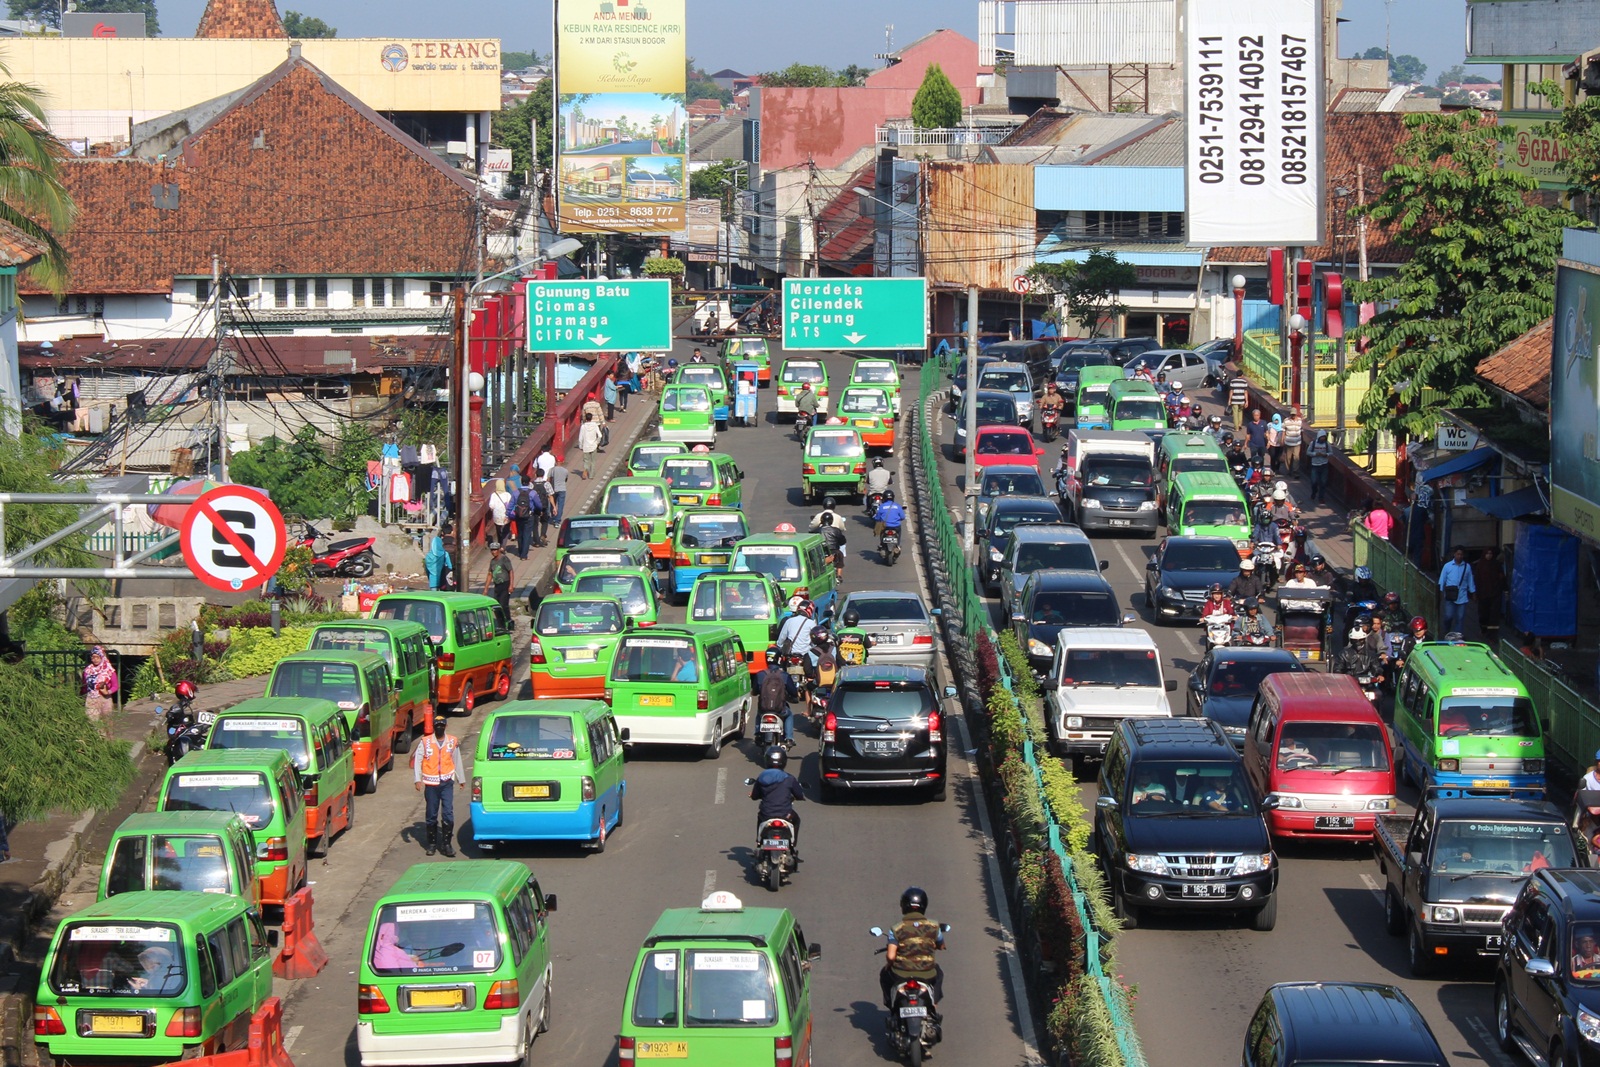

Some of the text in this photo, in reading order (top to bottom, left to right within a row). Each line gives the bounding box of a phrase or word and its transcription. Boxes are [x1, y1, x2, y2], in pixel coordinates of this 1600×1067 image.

[593, 12, 652, 21] ANDA MENUJU
[563, 24, 681, 36] KEBUN RAYA RESIDENCE (KRR)
[411, 42, 498, 59] TERANG
[597, 74, 651, 86] Kebun Raya
[1198, 36, 1224, 184] 0251-7539111
[1238, 35, 1265, 185] 08129414052
[1281, 34, 1307, 185] 085218157467
[1531, 139, 1570, 162] GRAN
[573, 207, 594, 218] Telp.
[597, 207, 620, 217] 0251
[630, 206, 654, 217] 8638
[656, 206, 674, 216] 777
[535, 285, 629, 300] Gunung Batu
[790, 283, 863, 296] Merdeka
[535, 300, 596, 311] Ciomas
[790, 298, 863, 310] Cilendek
[535, 314, 608, 328] Dramaga
[790, 312, 855, 327] Parung
[536, 329, 584, 341] CIFOR
[1447, 428, 1467, 439] WC
[200, 712, 217, 724] OJE
[865, 741, 870, 749] F
[1315, 816, 1320, 824] F
[1183, 885, 1188, 893] B
[716, 895, 727, 904] 02
[1487, 936, 1502, 946] F 8
[476, 953, 491, 964] 07
[94, 1016, 99, 1026] F
[637, 1043, 687, 1052] F 1923 AK
